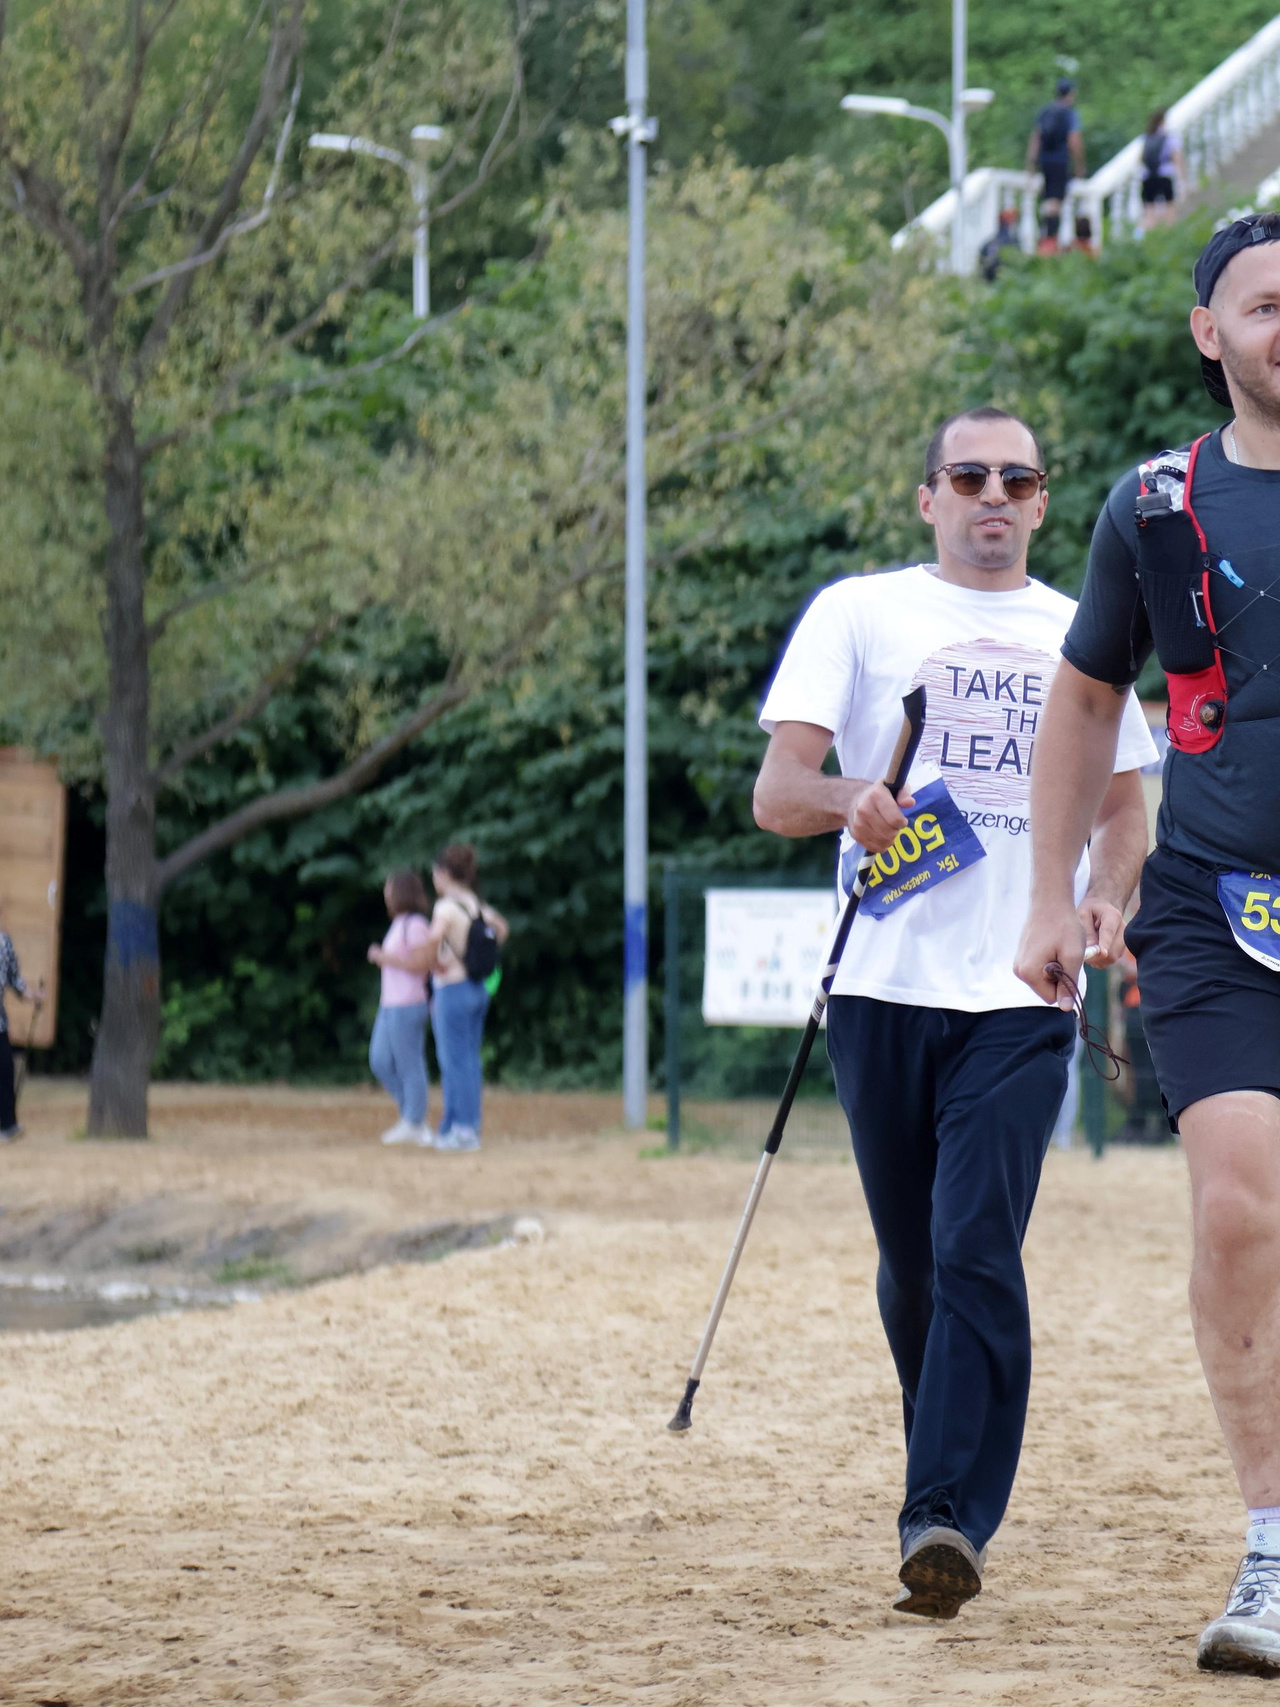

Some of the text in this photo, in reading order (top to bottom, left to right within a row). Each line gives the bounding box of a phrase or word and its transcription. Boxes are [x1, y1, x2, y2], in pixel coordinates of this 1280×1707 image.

[945, 665, 1043, 706] TAKE
[1001, 708, 1038, 735] TH
[940, 731, 1035, 776] LEA
[959, 809, 1032, 836] azenge
